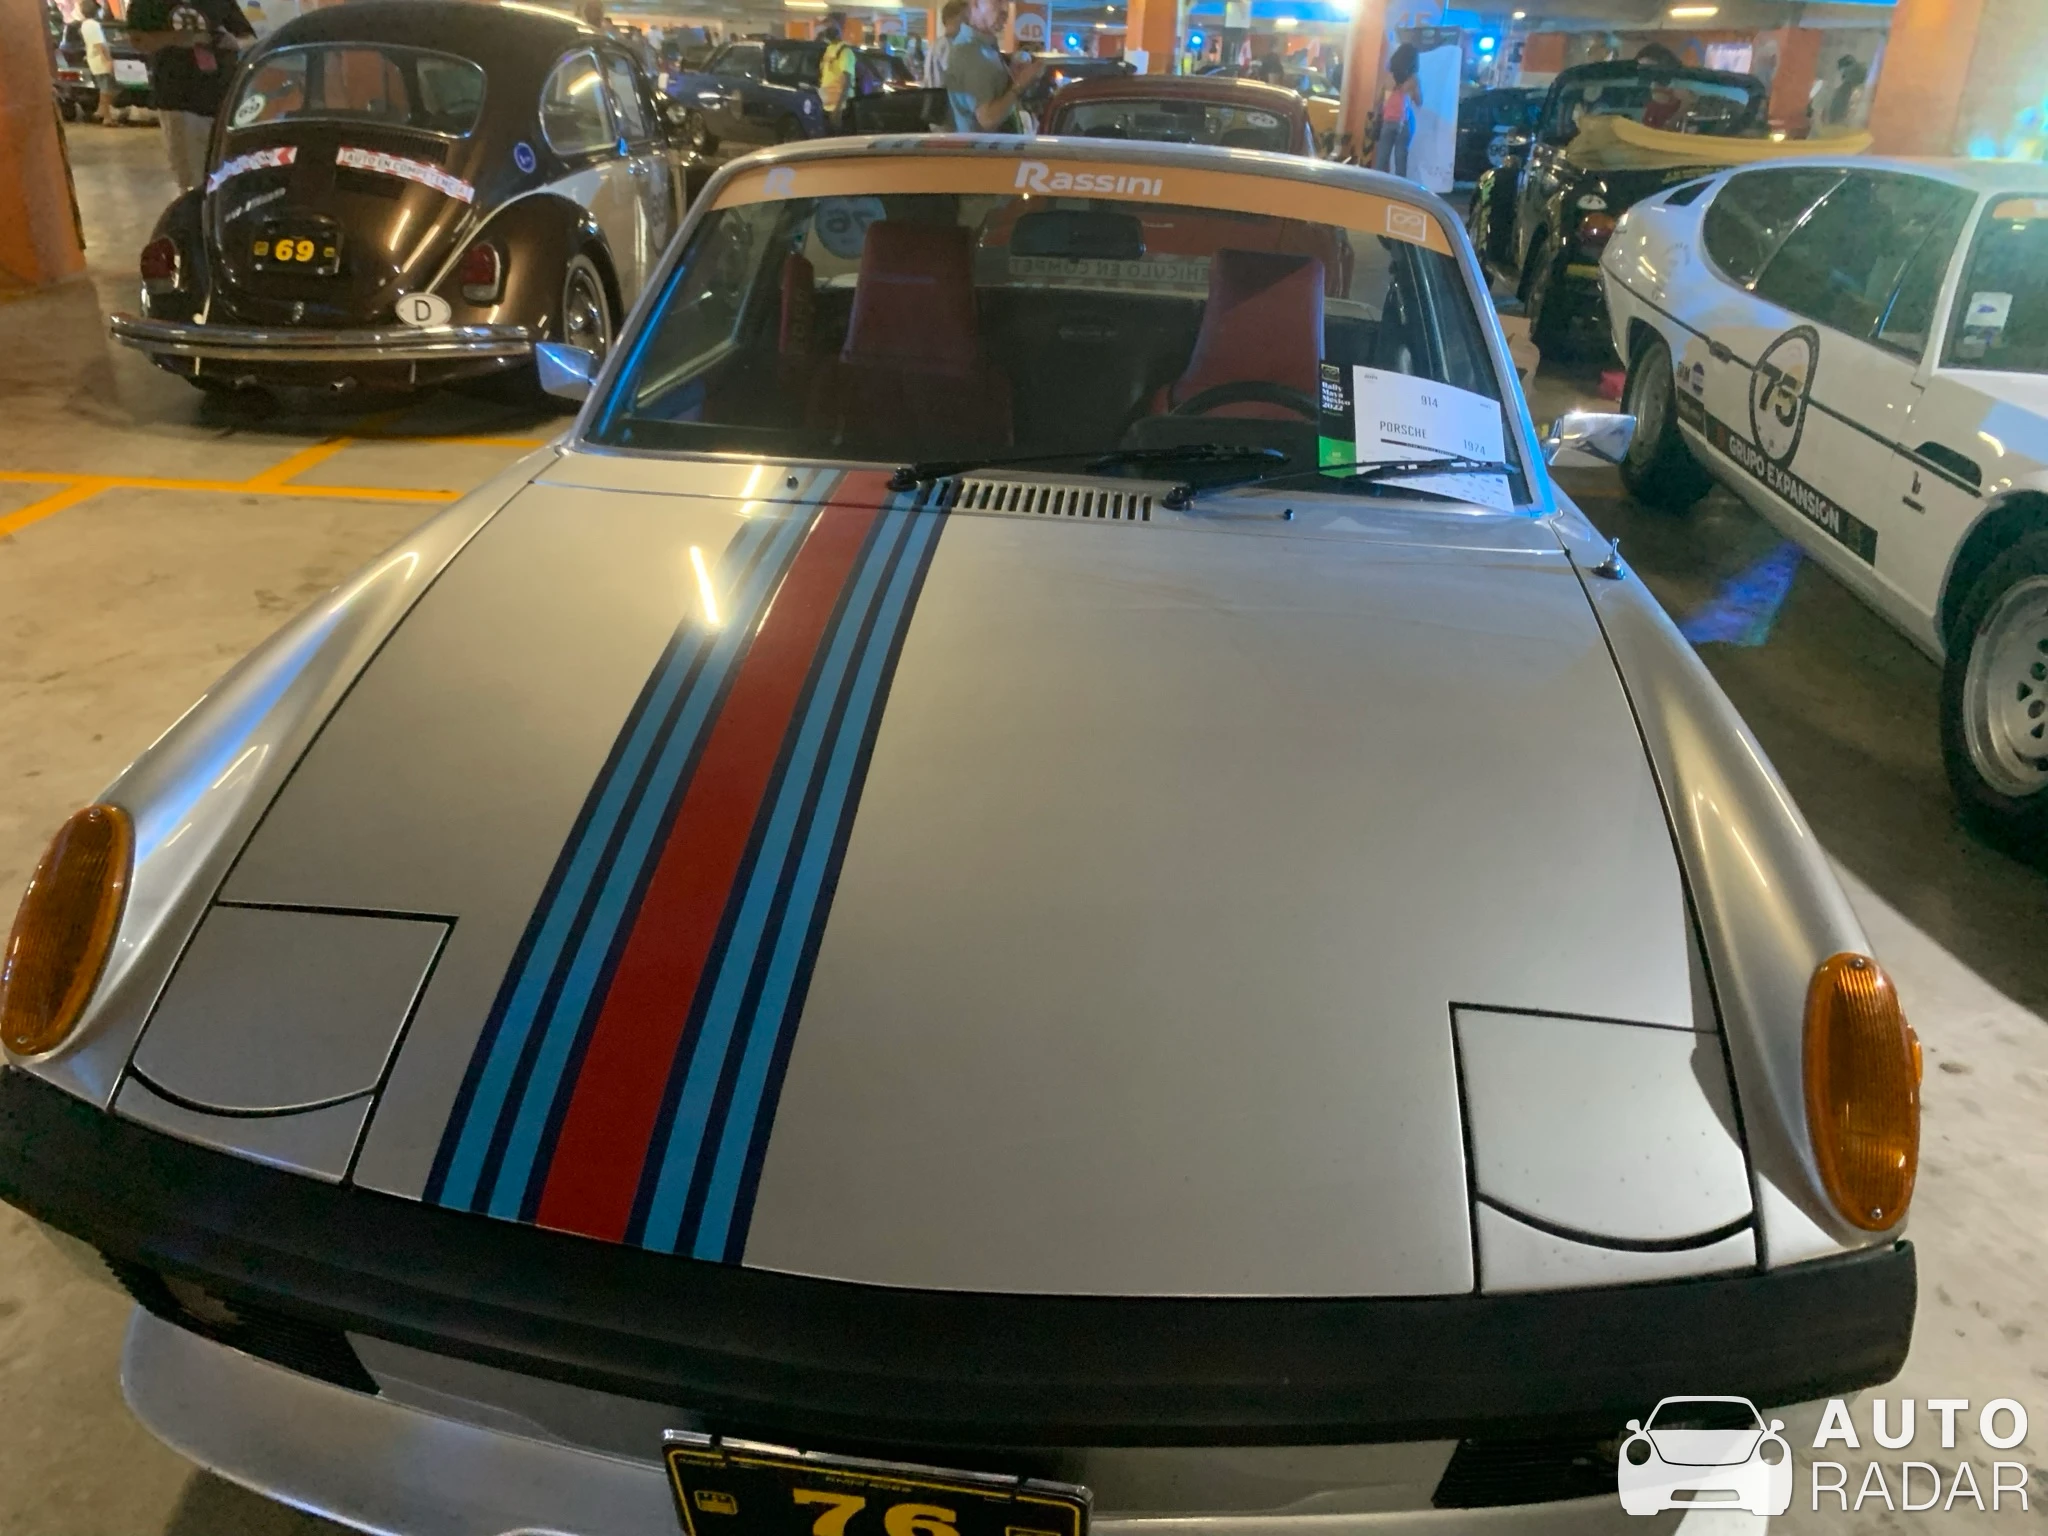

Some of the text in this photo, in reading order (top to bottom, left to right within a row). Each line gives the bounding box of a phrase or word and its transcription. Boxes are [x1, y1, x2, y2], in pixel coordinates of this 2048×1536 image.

[347, 153, 376, 165] AUTO
[764, 167, 796, 198] R
[1014, 160, 1164, 197] Rassini
[275, 239, 315, 262] 69
[414, 300, 432, 322] D
[1321, 381, 1343, 392] Rally
[1759, 360, 1798, 428] 75
[1420, 394, 1439, 409] 914
[1379, 420, 1428, 440] PORSCHE
[1463, 438, 1487, 457] 1974
[1729, 435, 1766, 477] GRUPO
